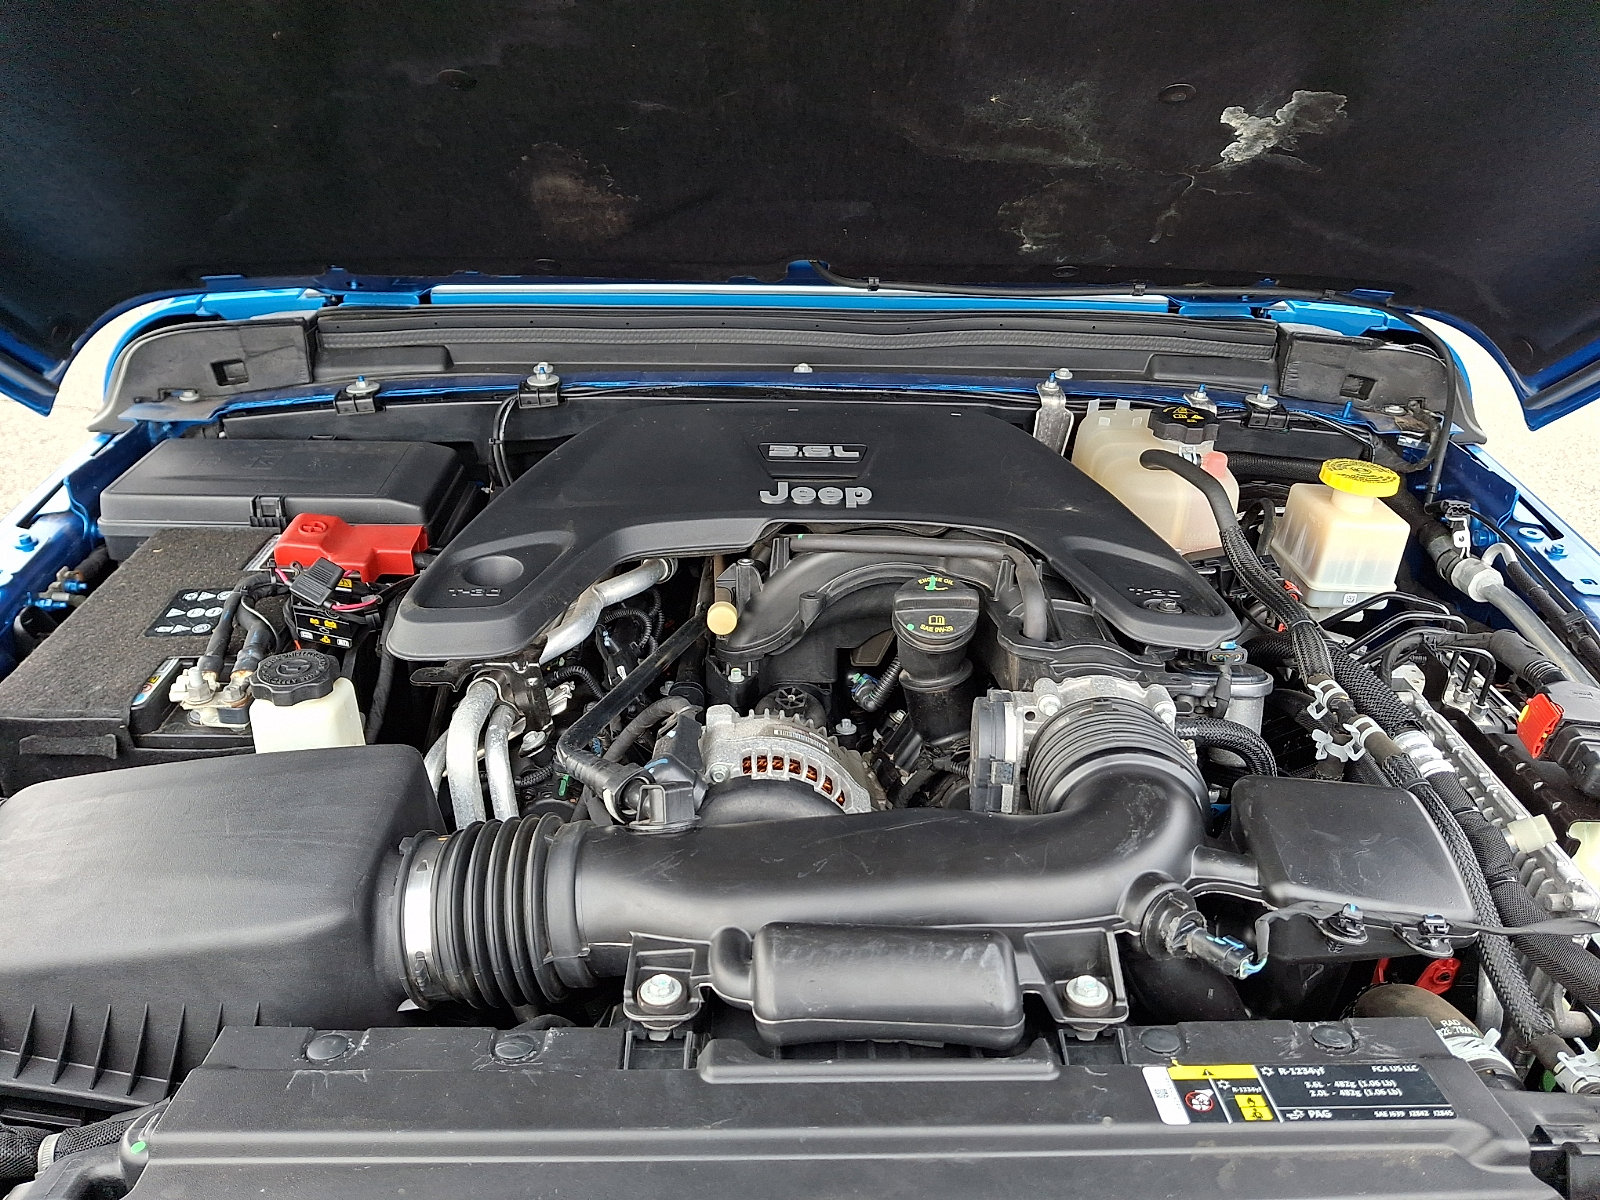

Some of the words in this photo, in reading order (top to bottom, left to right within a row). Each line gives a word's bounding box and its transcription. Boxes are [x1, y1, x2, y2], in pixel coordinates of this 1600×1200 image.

[760, 481, 872, 508] Jeep
[917, 576, 943, 585] ENGNE
[943, 578, 954, 586] OIL
[920, 623, 934, 632] SAE
[1440, 1019, 1461, 1027] RAD
[1277, 1066, 1326, 1077] R-1234yf
[1371, 1065, 1389, 1073] FCA
[1389, 1065, 1402, 1073] US
[1402, 1064, 1420, 1072] LLC
[1231, 1086, 1263, 1094] R-1234yf
[1307, 1109, 1333, 1119] PAG
[1373, 1110, 1389, 1118] SAE
